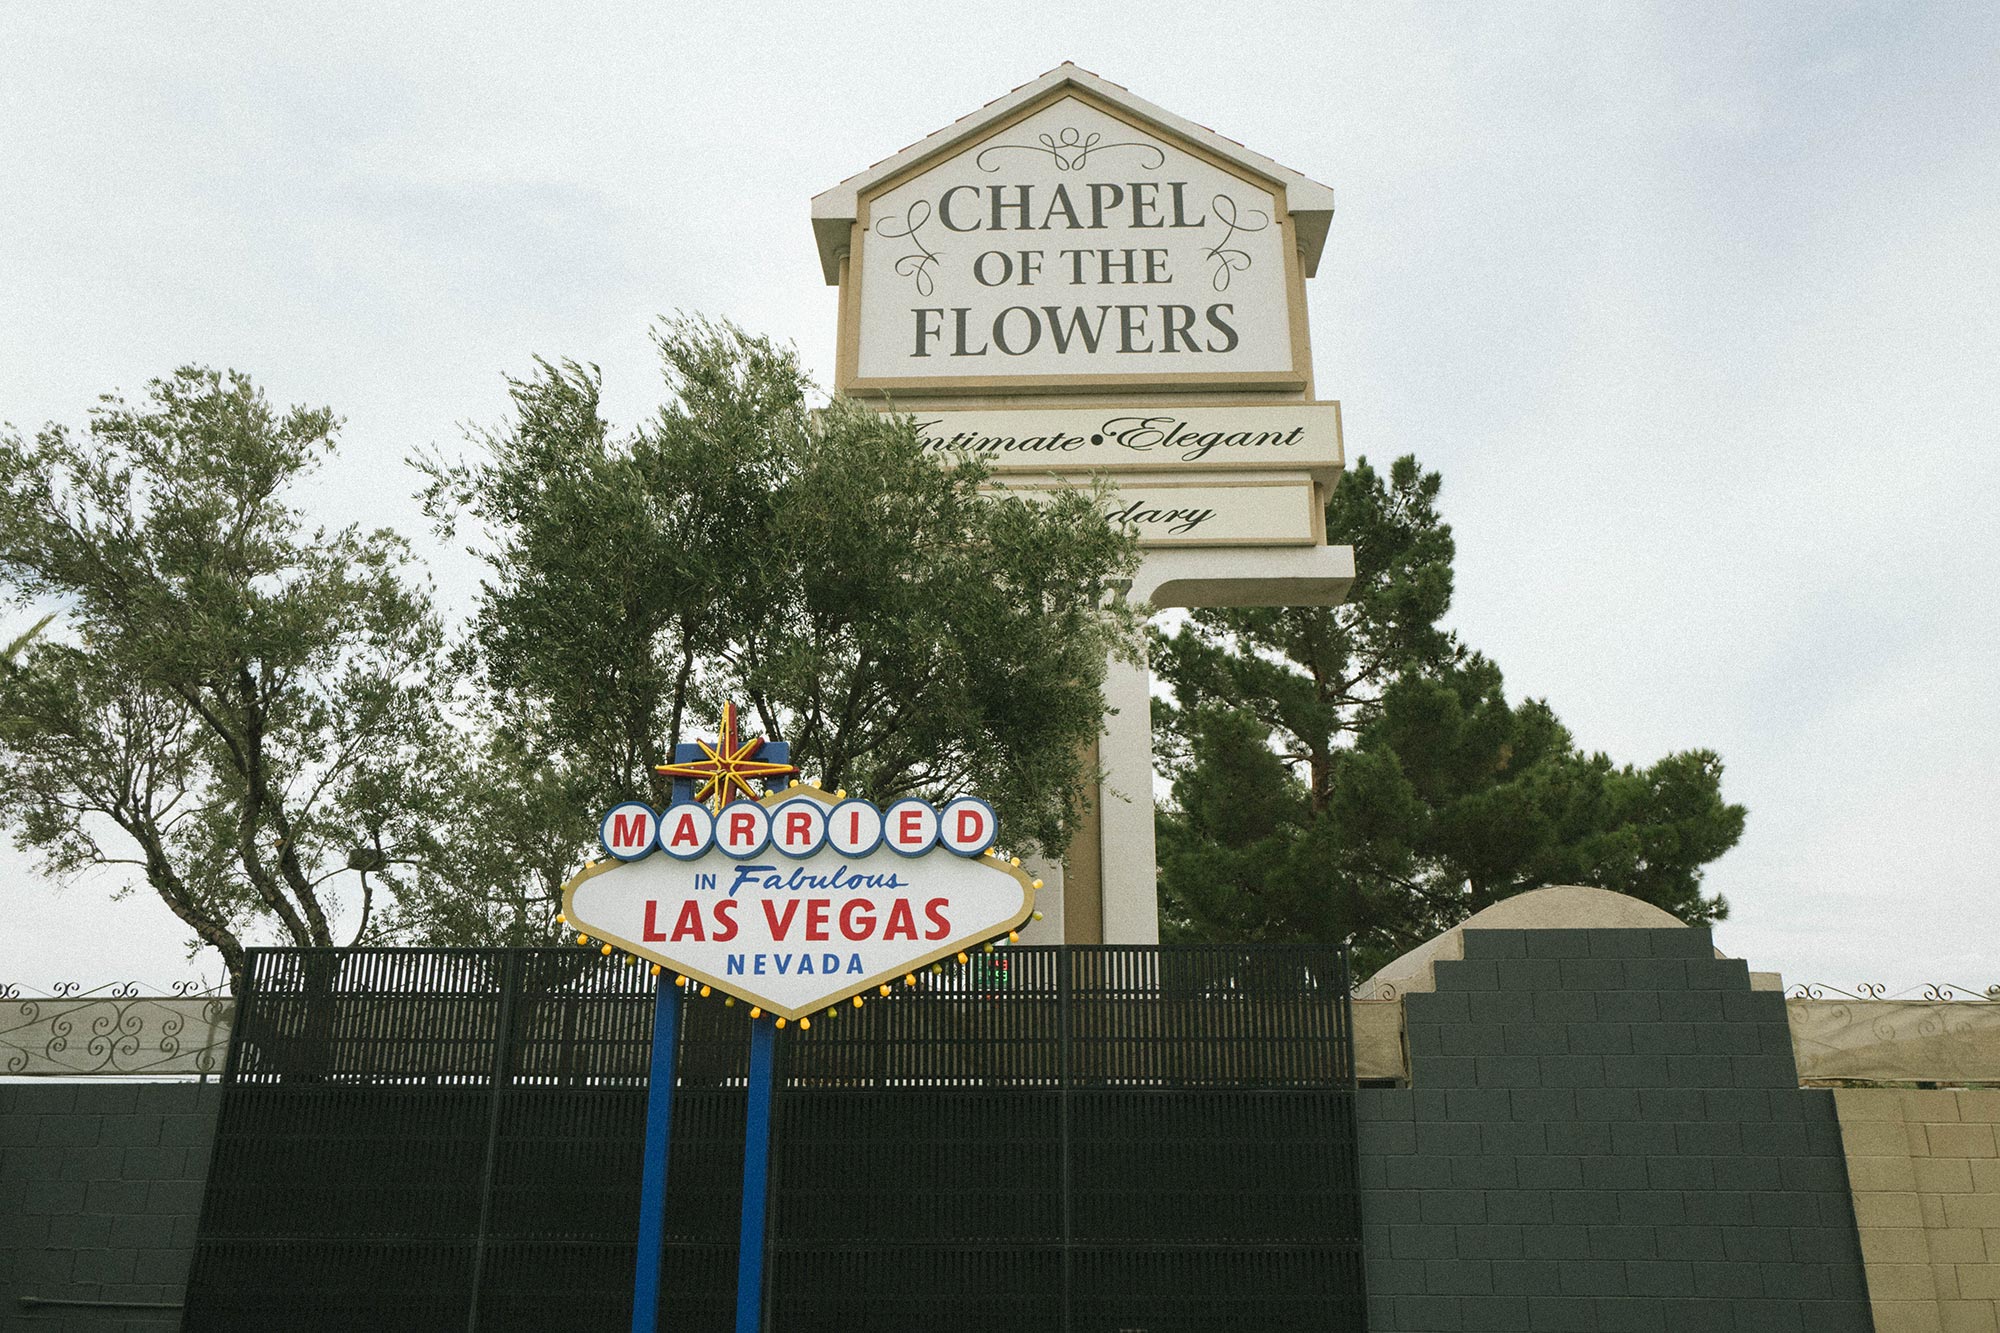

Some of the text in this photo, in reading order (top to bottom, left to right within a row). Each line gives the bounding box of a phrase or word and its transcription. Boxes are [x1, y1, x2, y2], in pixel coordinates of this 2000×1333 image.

[938, 181, 1206, 233] CHAPEL
[973, 248, 1173, 287] OF THE
[909, 303, 1239, 358] FLOWERS
[1101, 416, 1305, 462] Elegant
[612, 809, 984, 848] MARRIED
[695, 865, 909, 897] IN Fabulous
[643, 897, 951, 943] LAS VEGAS
[726, 952, 865, 976] NEVADA
